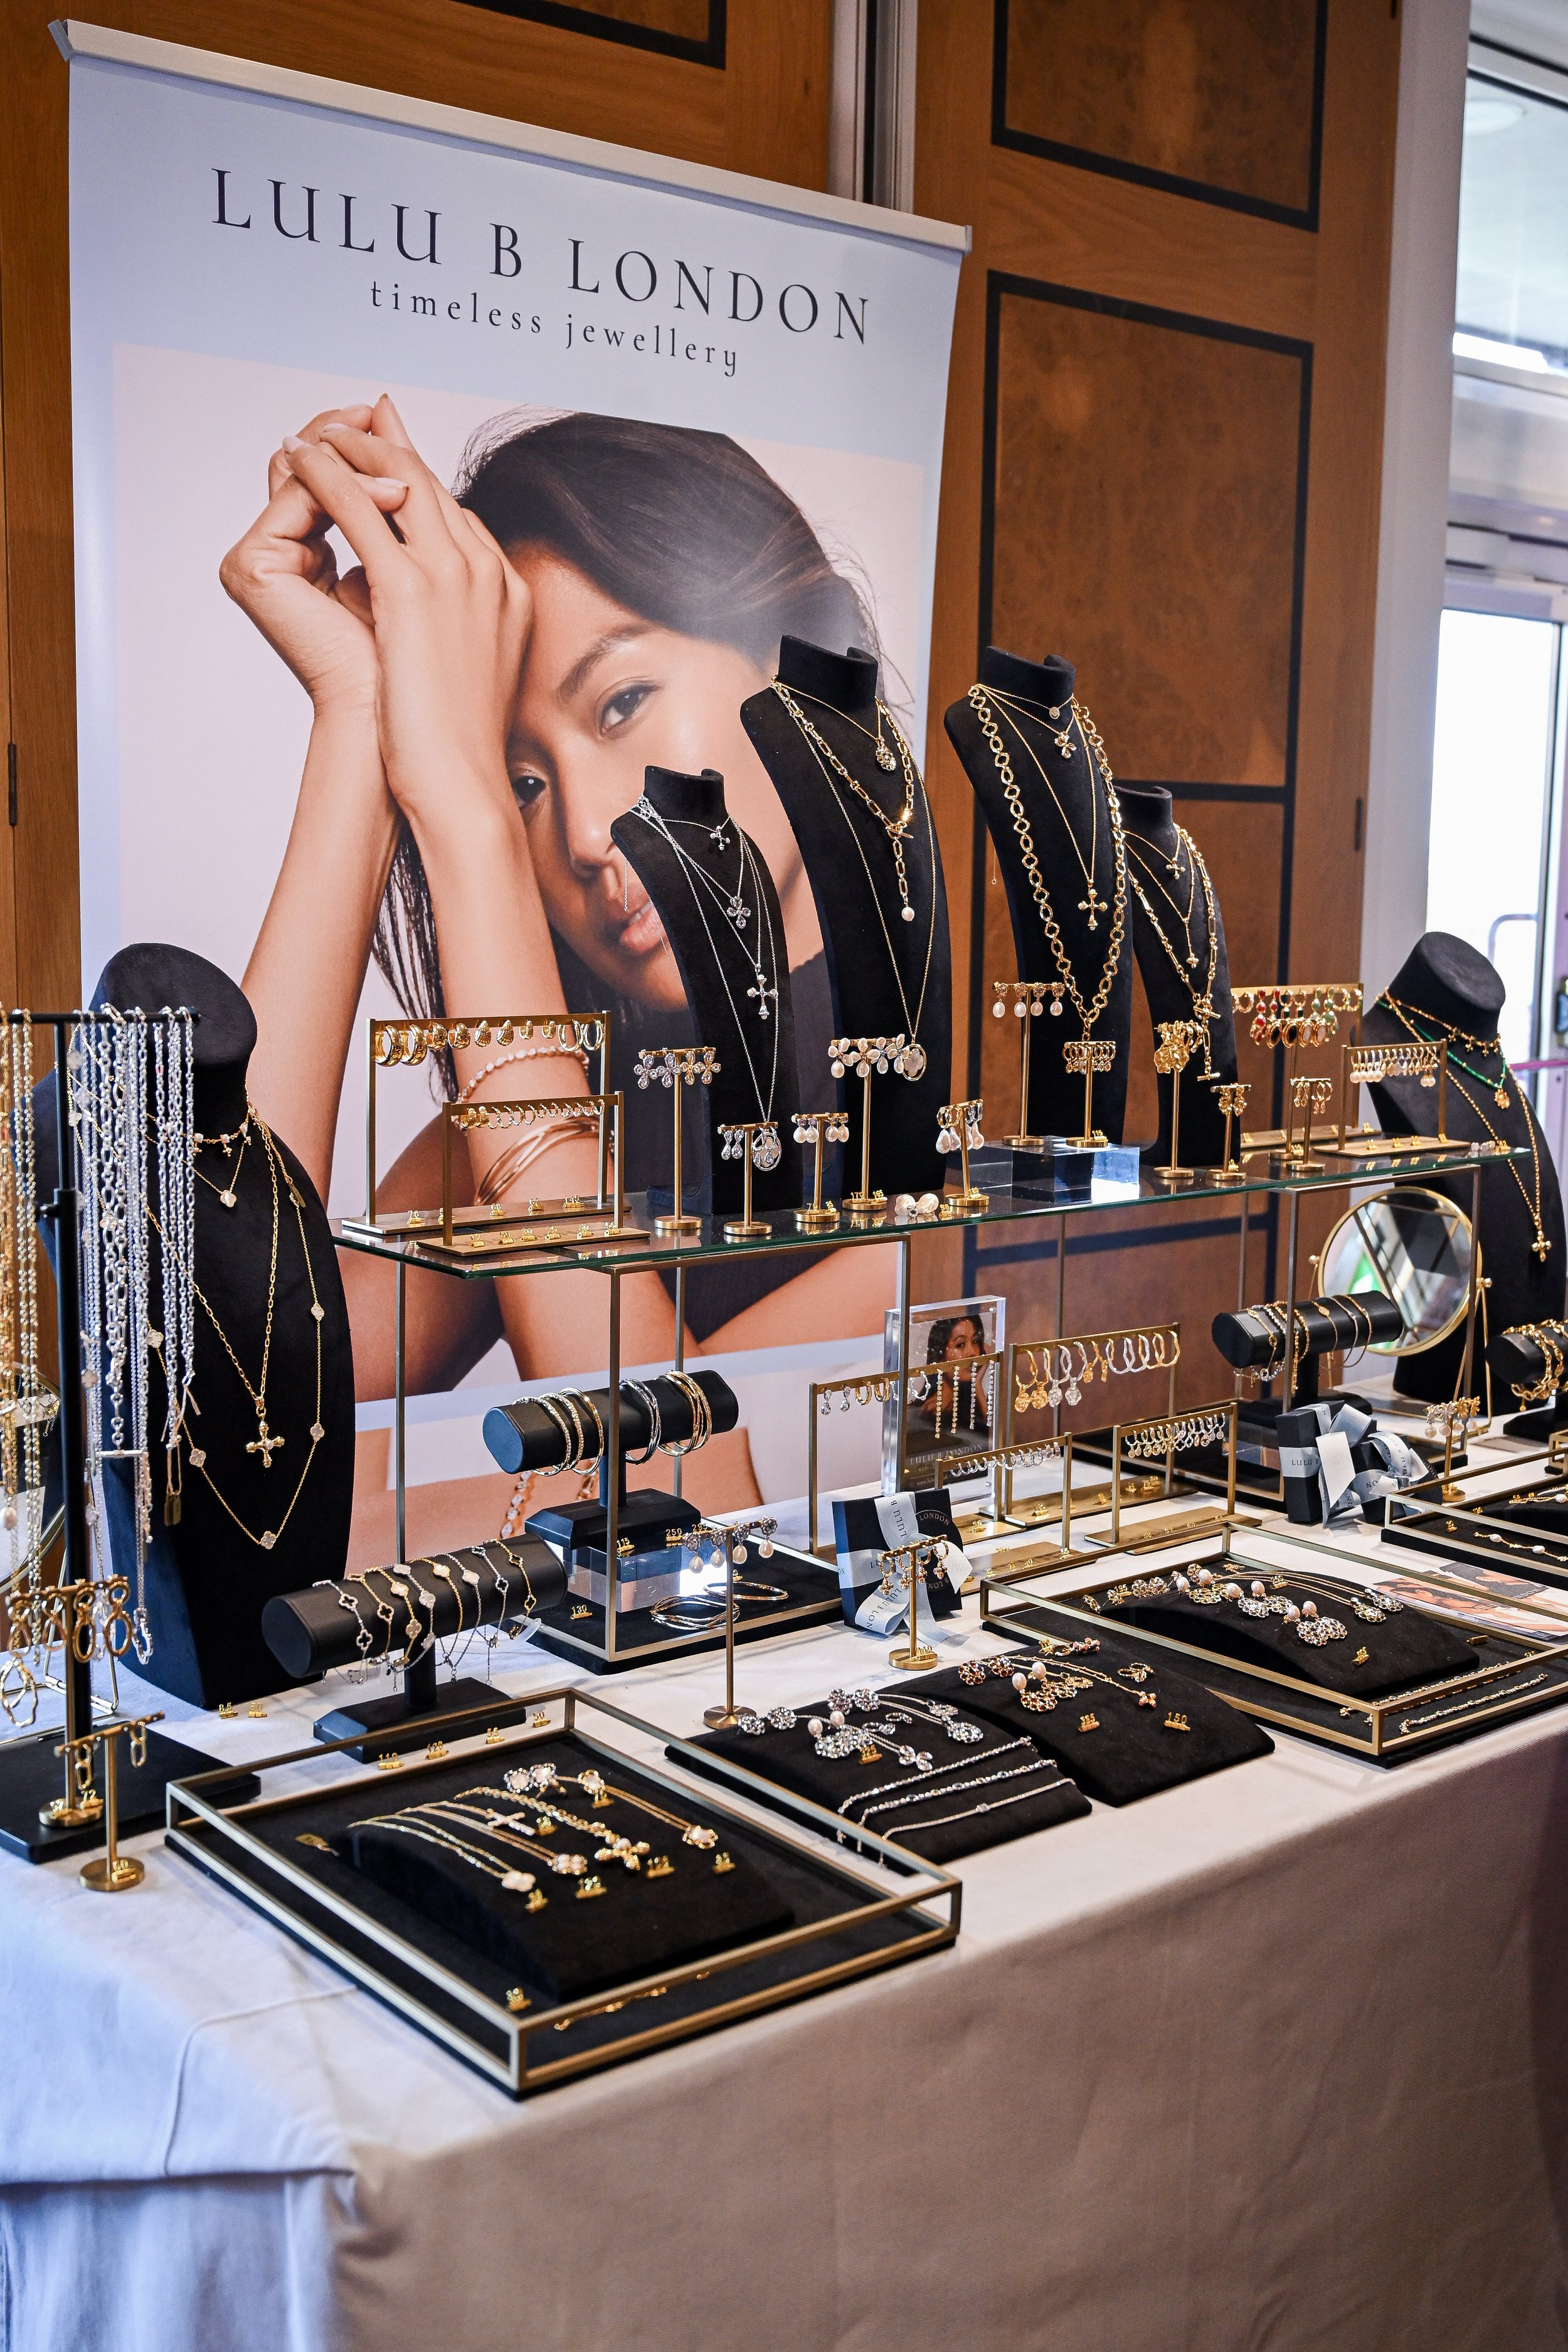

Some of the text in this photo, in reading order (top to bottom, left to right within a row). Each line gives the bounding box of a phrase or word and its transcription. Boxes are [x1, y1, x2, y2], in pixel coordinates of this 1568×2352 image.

[211, 169, 869, 344] LULU B LONDON
[371, 282, 736, 376] timeless jewellery
[910, 1454, 934, 1465] LULU
[893, 1509, 908, 1538] LULU
[919, 1512, 950, 1526] LONDON
[665, 1528, 683, 1537] 250
[616, 1537, 630, 1548] 115
[882, 1588, 902, 1607] LULU
[571, 1604, 588, 1614] 130
[533, 1711, 546, 1722] 50
[1167, 1712, 1187, 1725] 150
